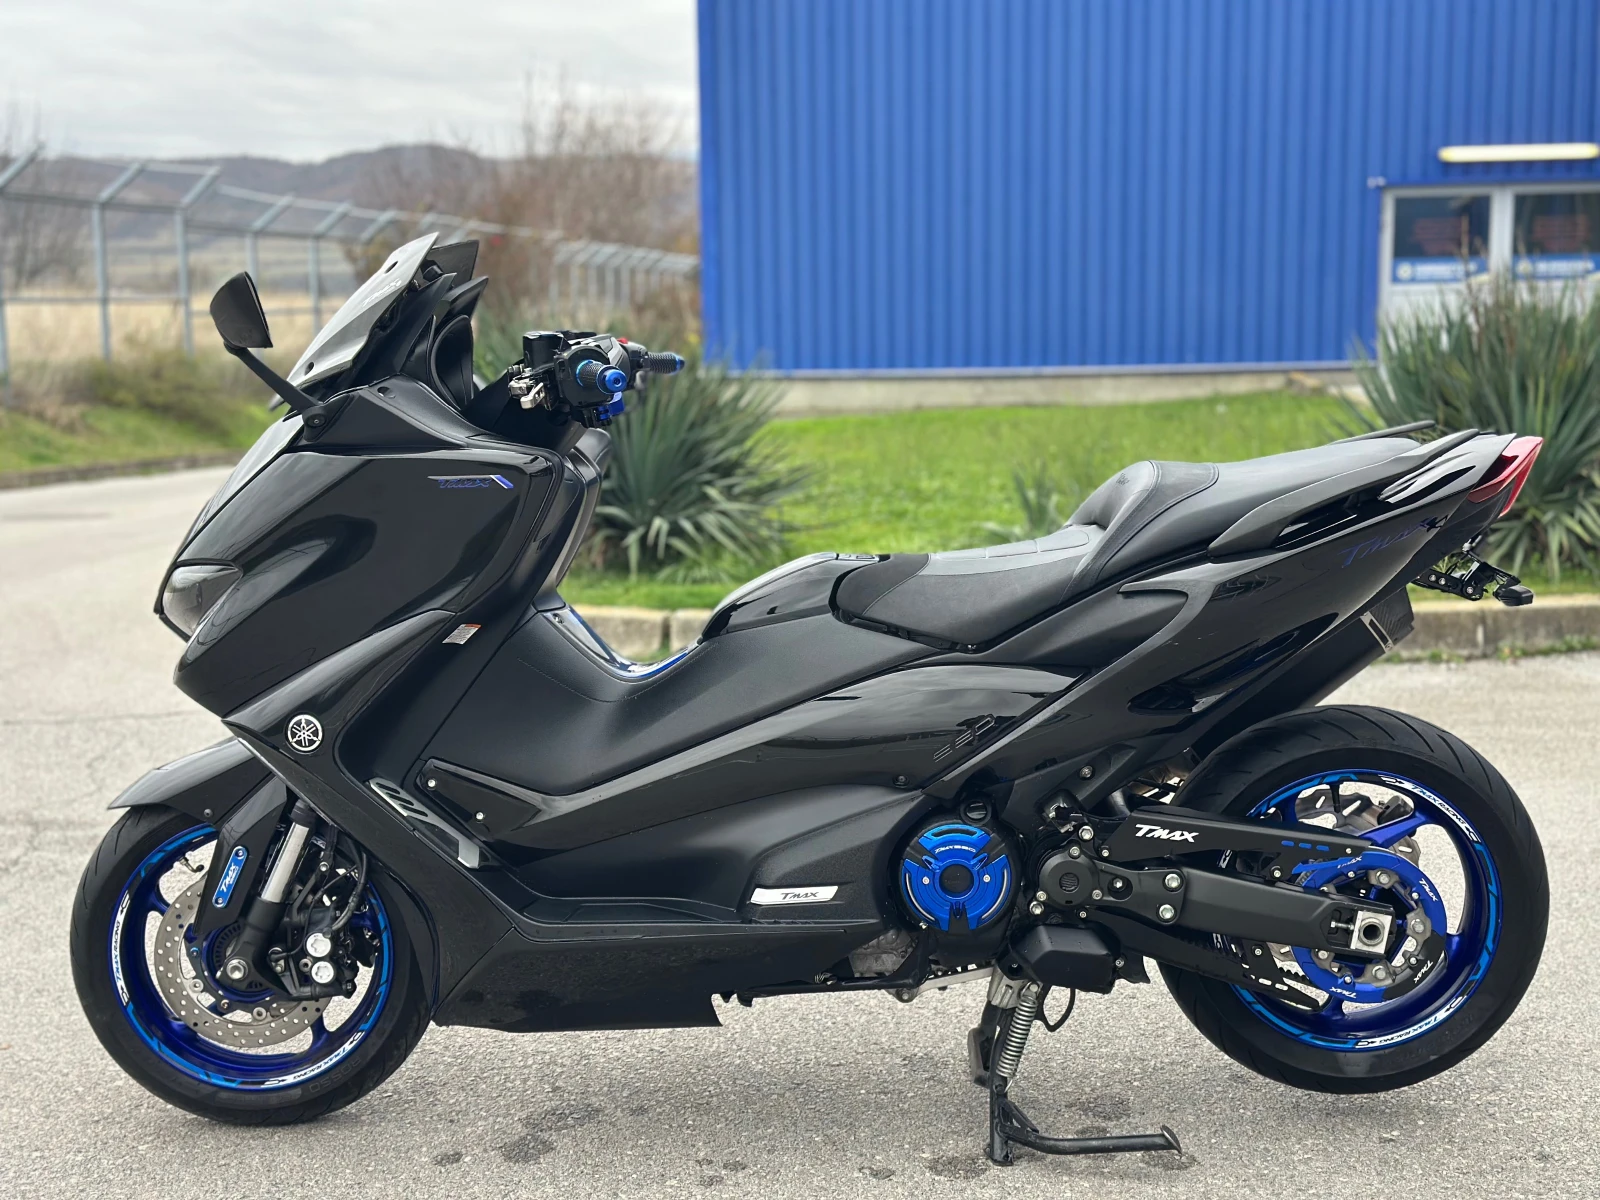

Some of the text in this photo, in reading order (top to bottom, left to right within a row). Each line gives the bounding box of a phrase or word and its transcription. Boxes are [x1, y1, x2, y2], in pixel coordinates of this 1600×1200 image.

[438, 478, 492, 488] TMAX
[1439, 802, 1466, 825] RACING
[1135, 823, 1200, 843] TMAX
[781, 891, 819, 901] TMAX
[1419, 877, 1439, 902] TMAX
[113, 920, 122, 982] TMAX RACING
[1413, 960, 1434, 984] TMAX
[1329, 986, 1357, 999] TMAX
